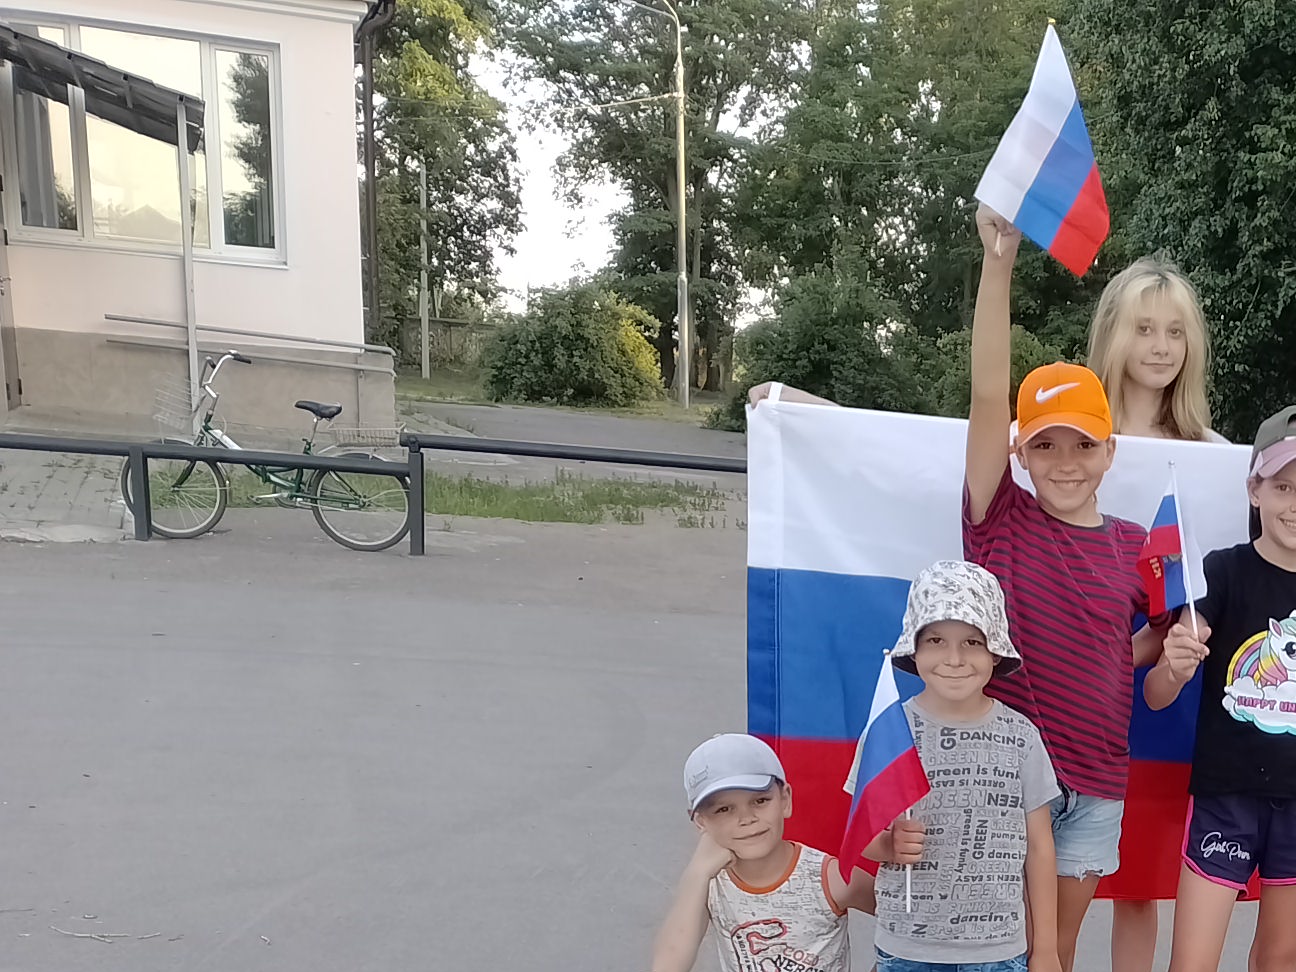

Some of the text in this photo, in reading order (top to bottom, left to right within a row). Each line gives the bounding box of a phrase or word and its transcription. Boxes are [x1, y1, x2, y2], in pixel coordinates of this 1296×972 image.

[1236, 695, 1278, 711] HAPPY
[960, 731, 1026, 748] DANCING
[927, 766, 971, 781] green
[976, 764, 989, 775] is
[972, 819, 989, 860] GREEN
[990, 832, 1016, 841] pump
